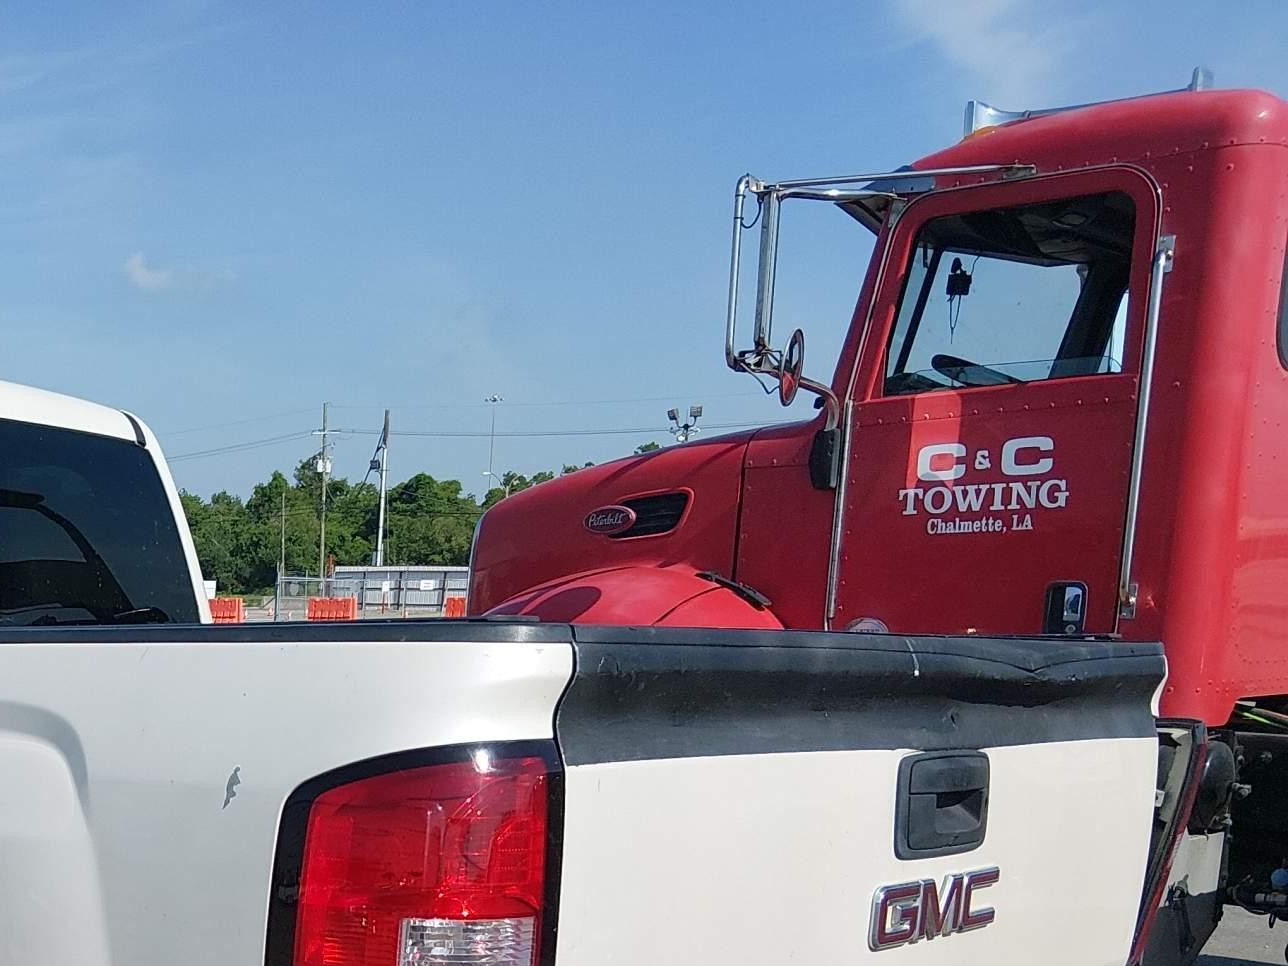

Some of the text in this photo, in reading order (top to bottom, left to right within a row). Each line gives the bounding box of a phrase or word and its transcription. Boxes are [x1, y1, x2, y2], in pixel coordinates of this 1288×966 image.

[917, 436, 1054, 481] C & C
[898, 479, 1070, 516] TOWING
[926, 514, 1033, 534] Chalmette, LA
[868, 866, 1000, 952] GMC
